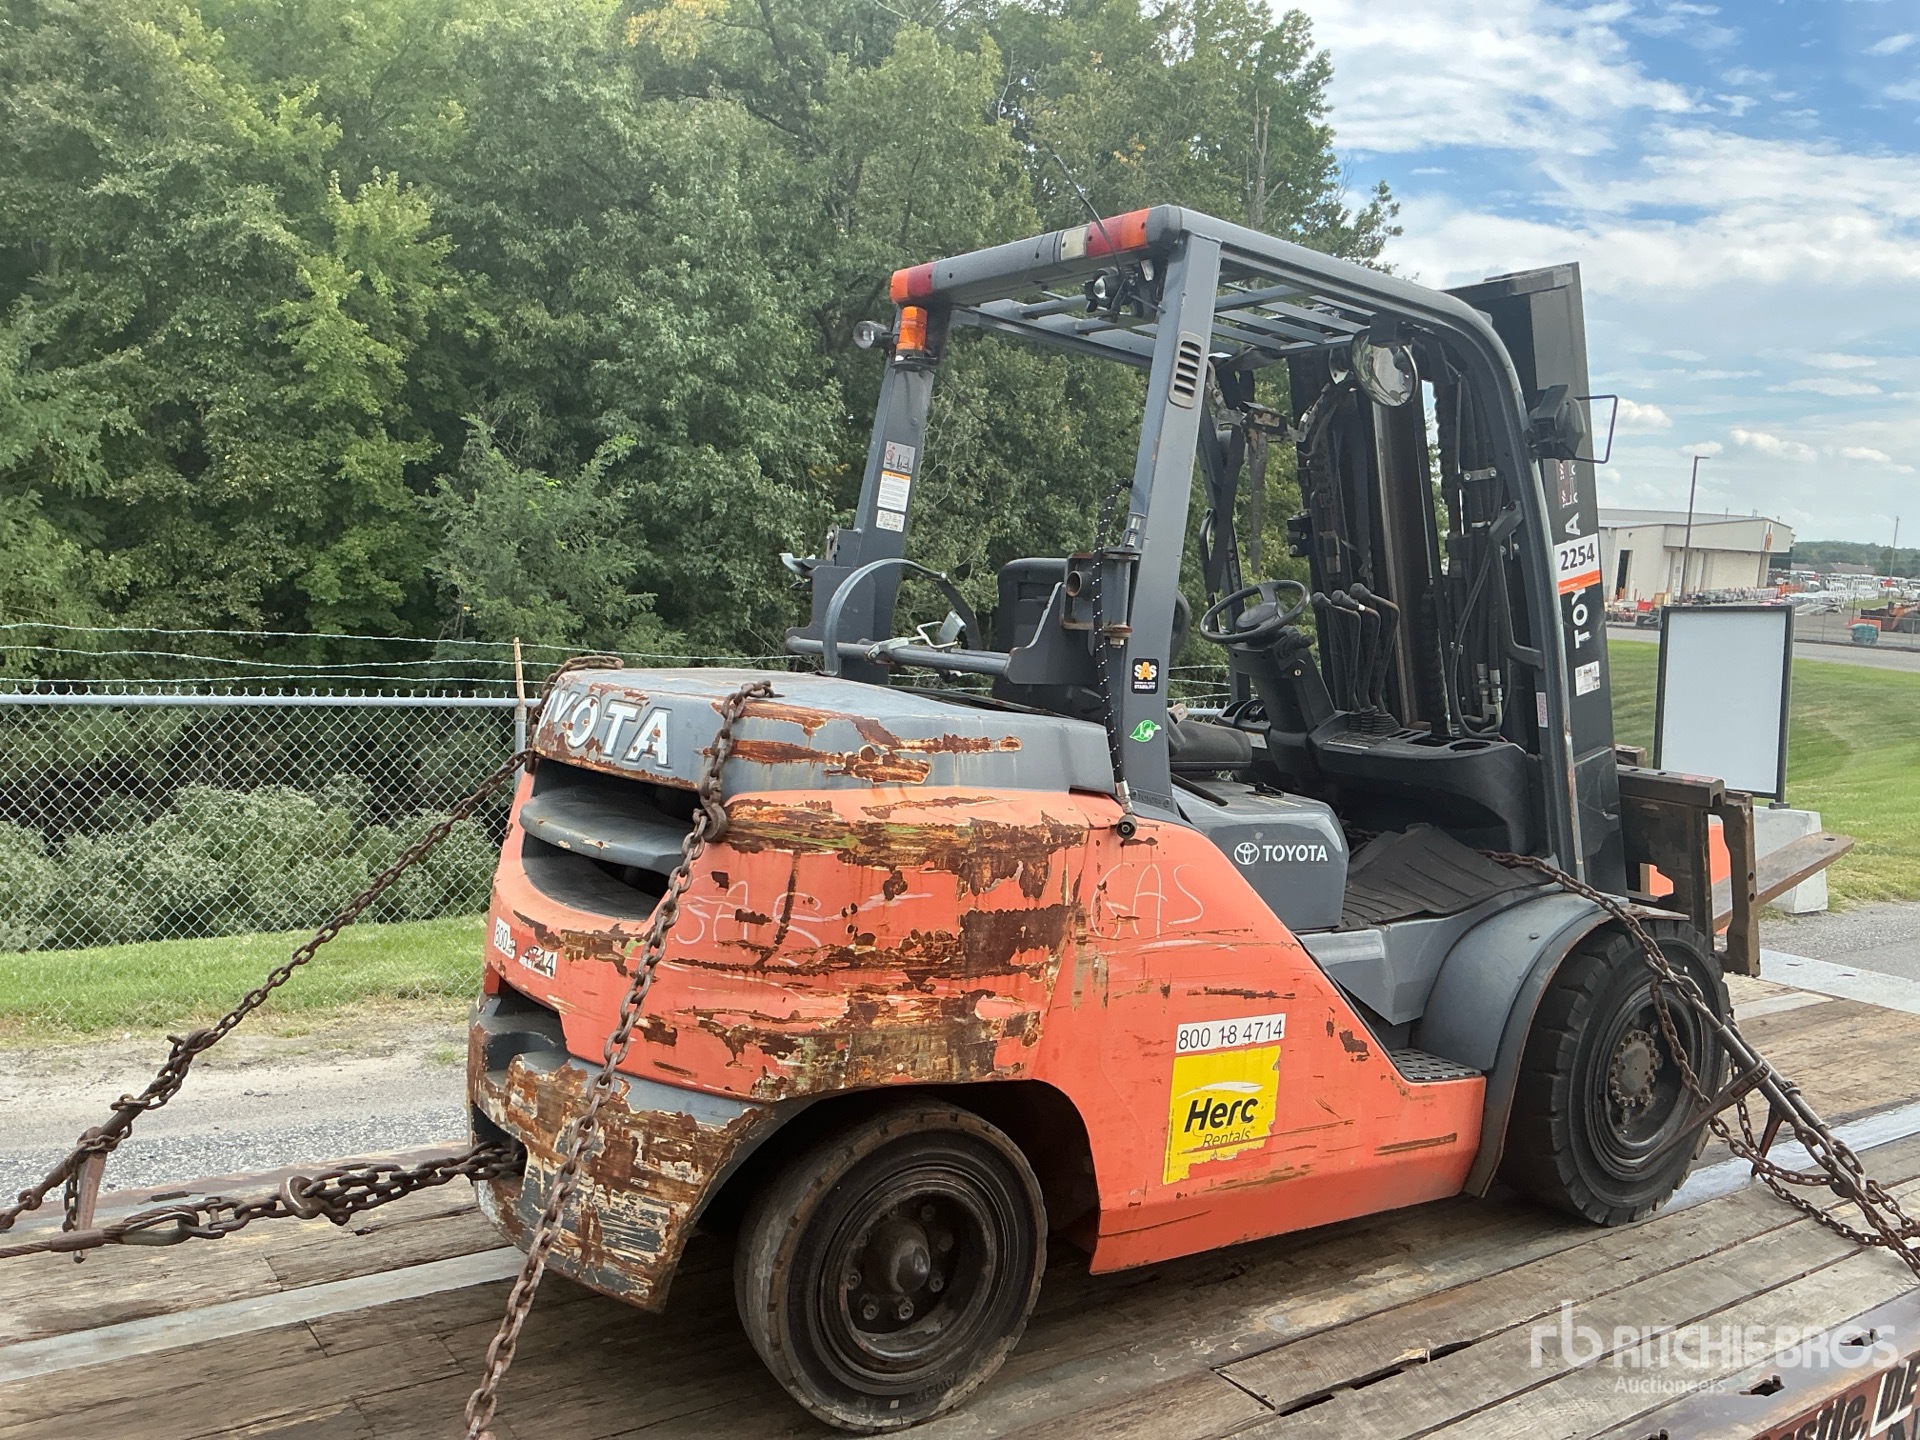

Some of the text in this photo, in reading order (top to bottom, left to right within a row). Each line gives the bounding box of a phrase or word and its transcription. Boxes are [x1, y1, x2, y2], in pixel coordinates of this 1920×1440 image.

[1561, 543, 1595, 571] 2254
[1134, 661, 1157, 681] SAS
[1262, 844, 1329, 862] TOYOTA
[1090, 862, 1204, 940] GAS
[1178, 1028, 1211, 1051] 800
[1242, 1019, 1283, 1042] 4714
[1184, 1097, 1259, 1133] Herc
[1203, 1128, 1251, 1147] Rentals
